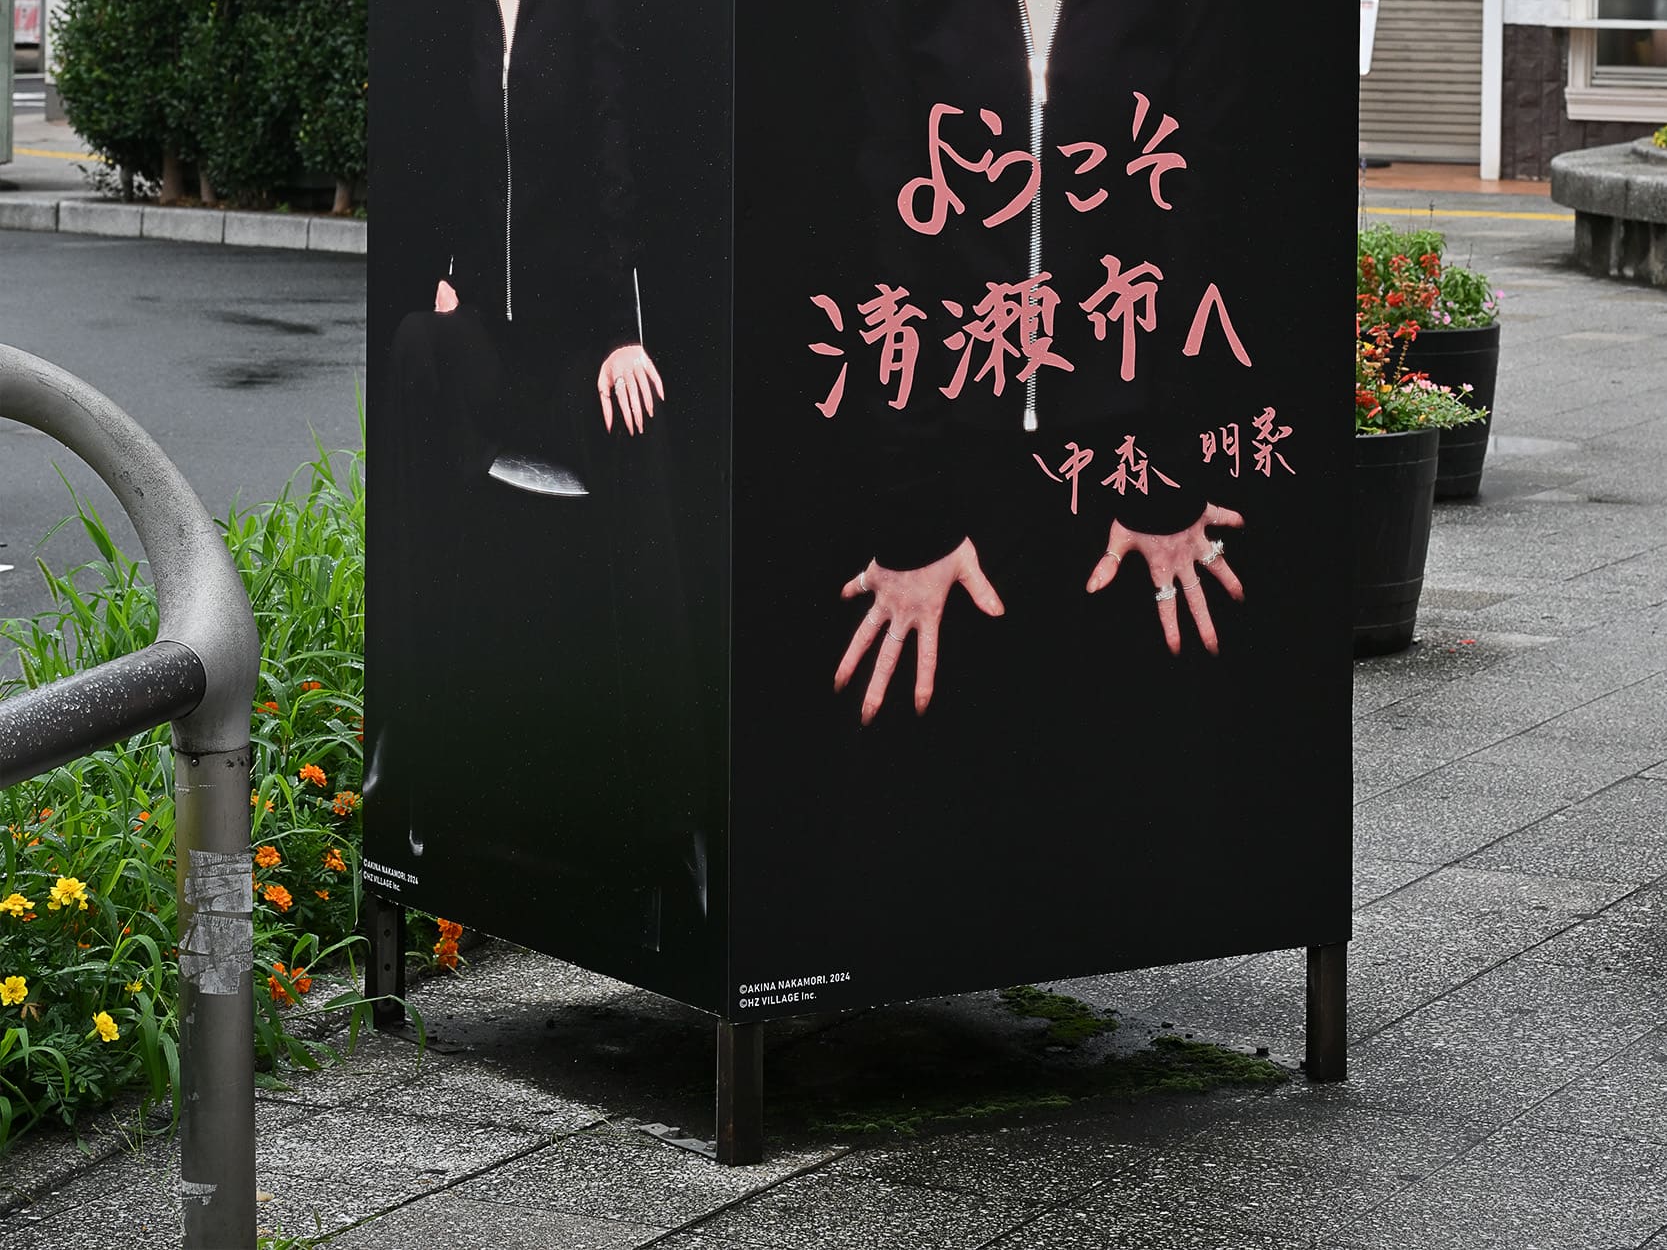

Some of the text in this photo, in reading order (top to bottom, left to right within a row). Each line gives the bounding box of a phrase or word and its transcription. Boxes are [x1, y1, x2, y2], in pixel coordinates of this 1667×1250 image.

[897, 91, 1187, 236] ようこそ
[829, 971, 851, 984] 2024
[761, 991, 800, 1006] VILLAGE
[801, 991, 817, 1001] Inc.
